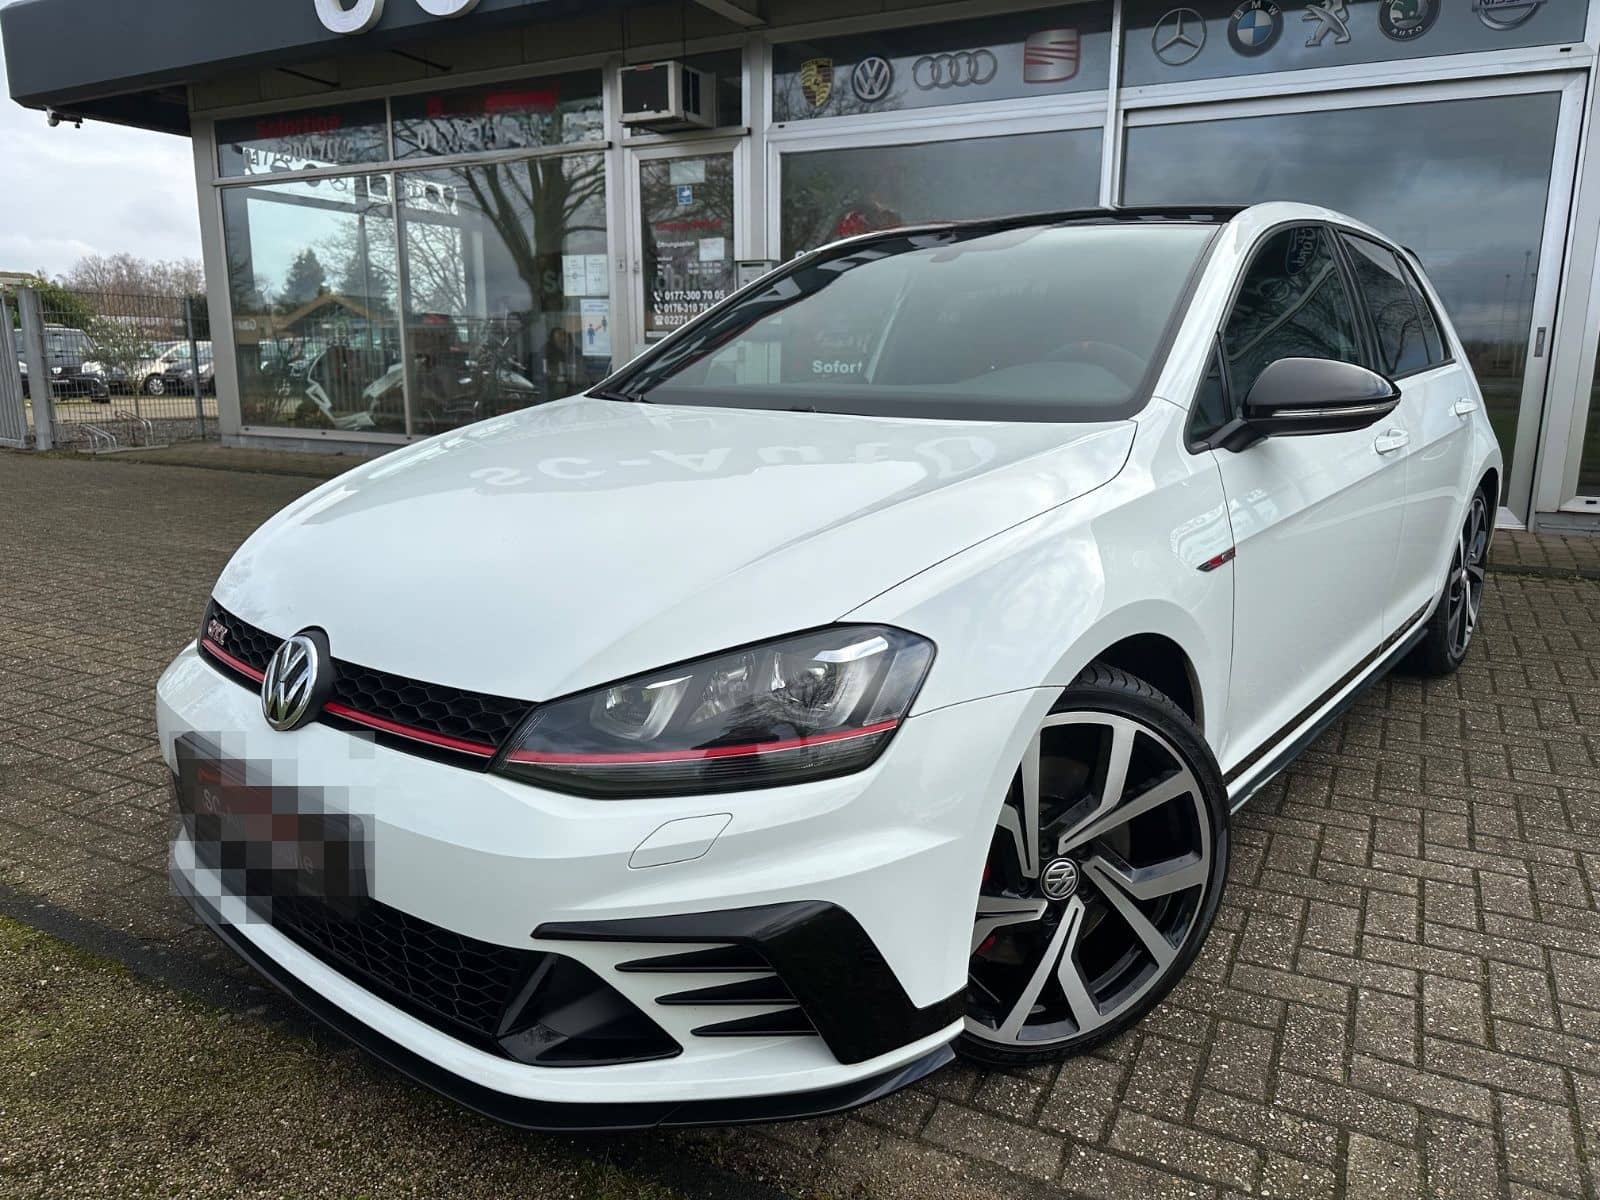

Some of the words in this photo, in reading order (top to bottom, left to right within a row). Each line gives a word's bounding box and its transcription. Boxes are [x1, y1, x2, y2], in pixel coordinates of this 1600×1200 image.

[1391, 25, 1423, 36] AUTO
[664, 290, 701, 300] 0177-300
[702, 290, 713, 300] 70
[812, 360, 863, 374] Sofort
